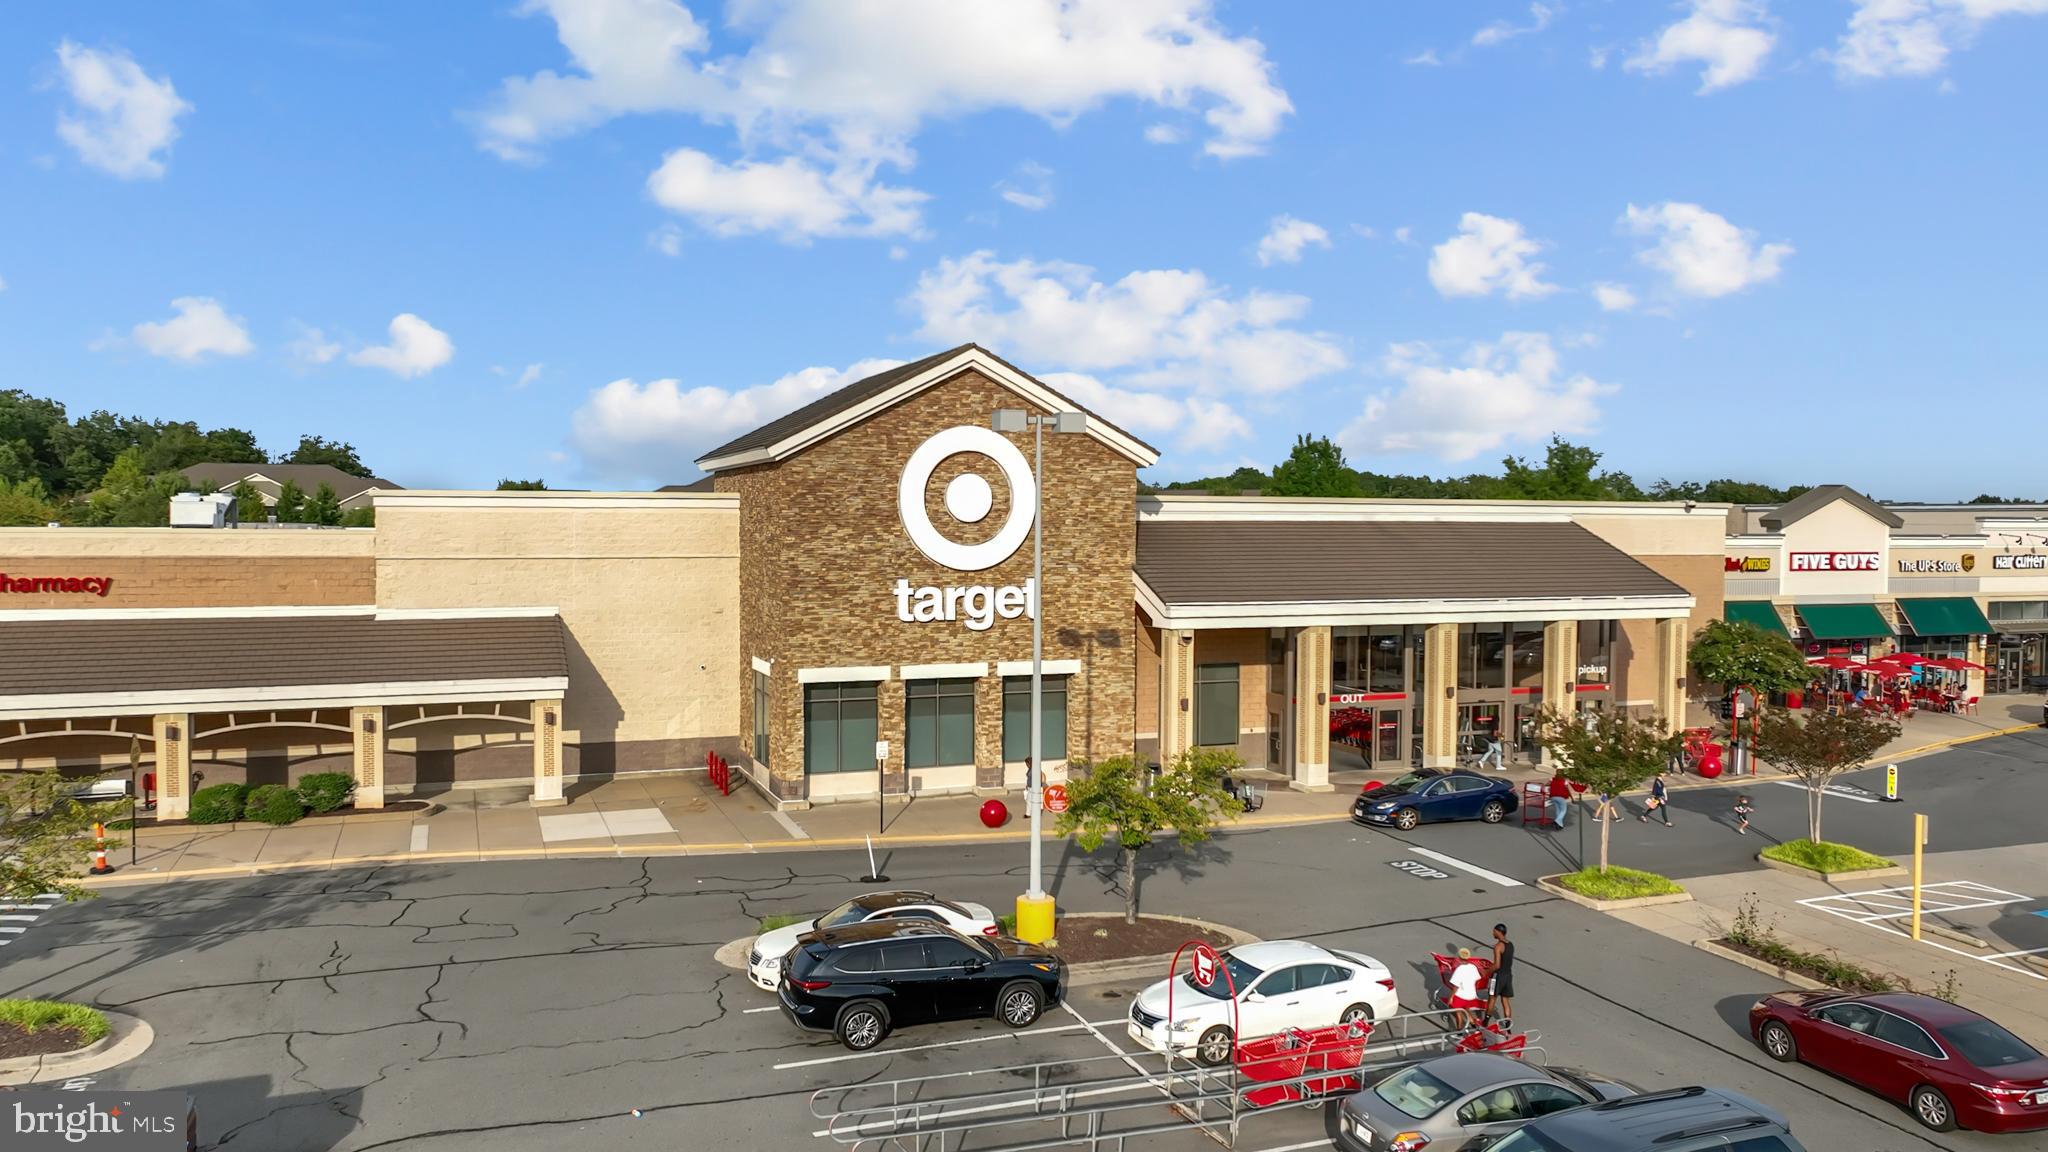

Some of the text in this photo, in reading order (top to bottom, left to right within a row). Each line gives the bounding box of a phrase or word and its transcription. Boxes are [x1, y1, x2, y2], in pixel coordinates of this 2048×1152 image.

[1791, 553, 1880, 570] FIVE GUYS
[1899, 560, 1960, 572] The UPS Store
[893, 578, 1035, 631] target
[1578, 664, 1607, 676] pickup
[1340, 694, 1364, 704] OUT
[1391, 861, 1448, 878] STOP
